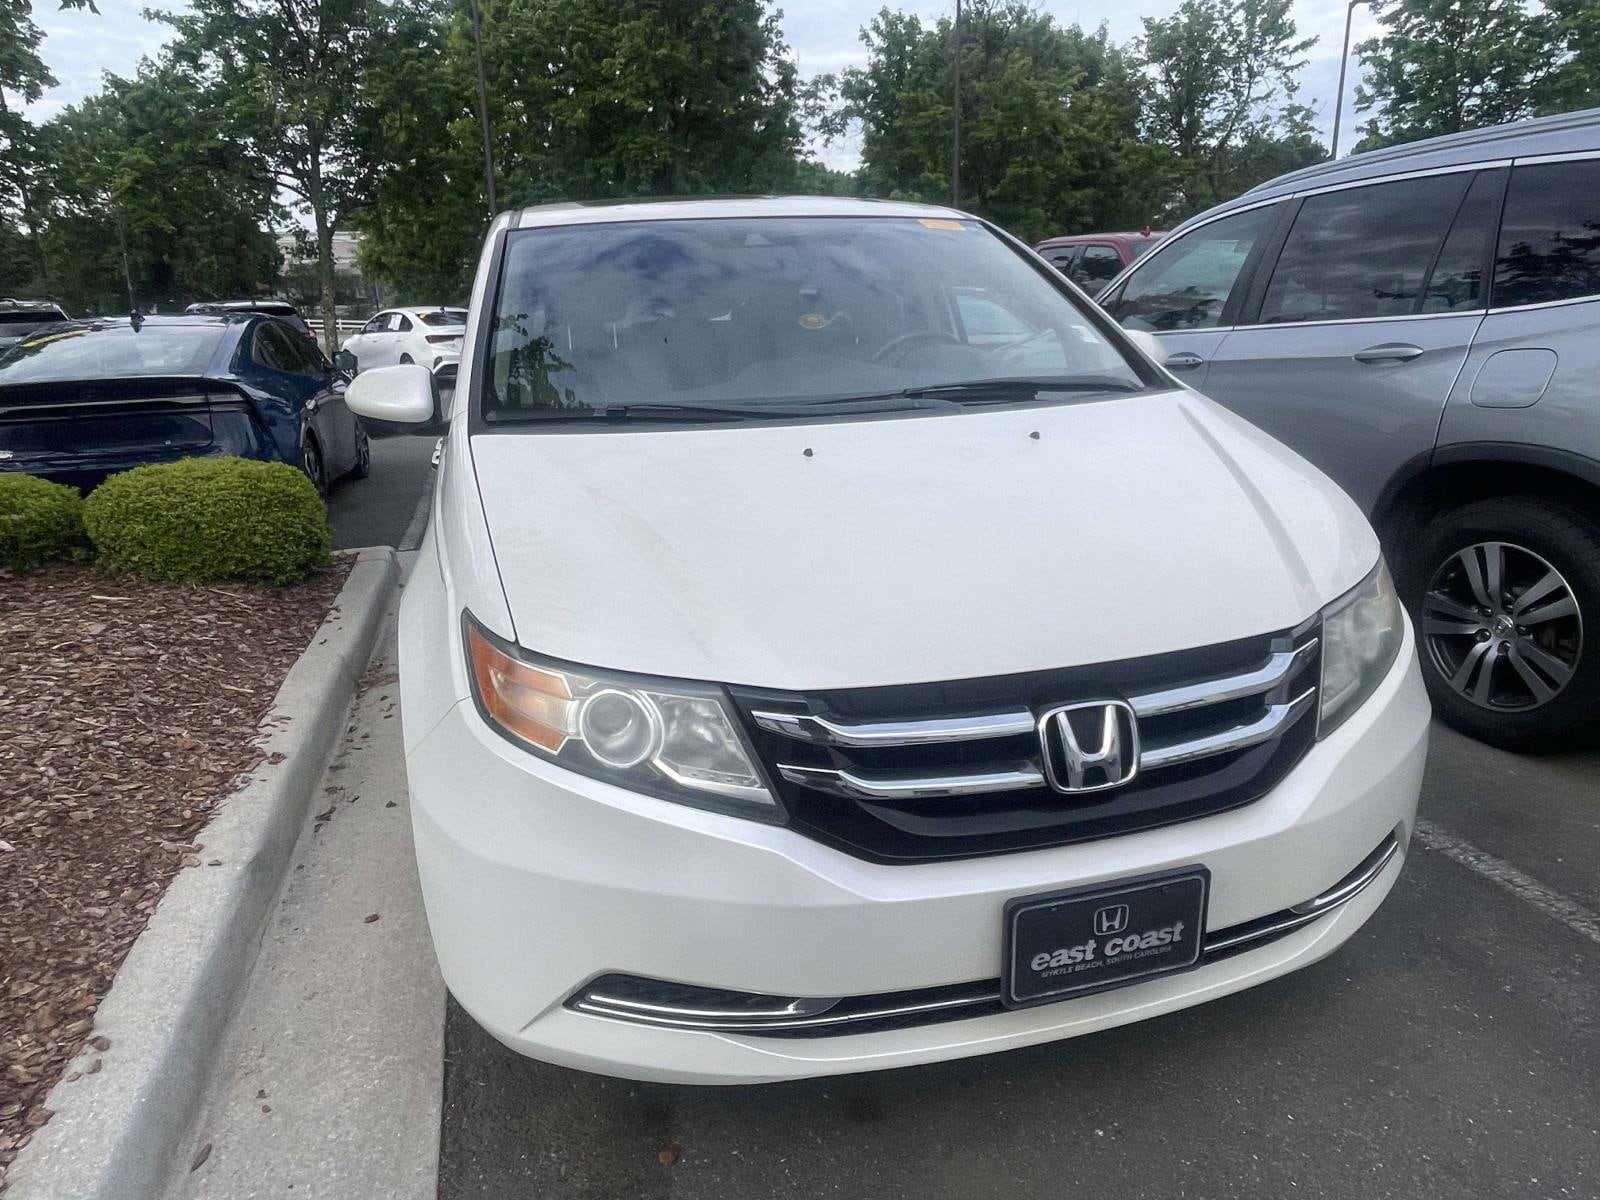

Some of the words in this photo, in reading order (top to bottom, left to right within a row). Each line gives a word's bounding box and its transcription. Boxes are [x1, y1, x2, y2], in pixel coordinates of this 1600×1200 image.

[1031, 938, 1097, 971] east
[1104, 921, 1185, 956] coast
[1041, 966, 1074, 978] MYRTLE
